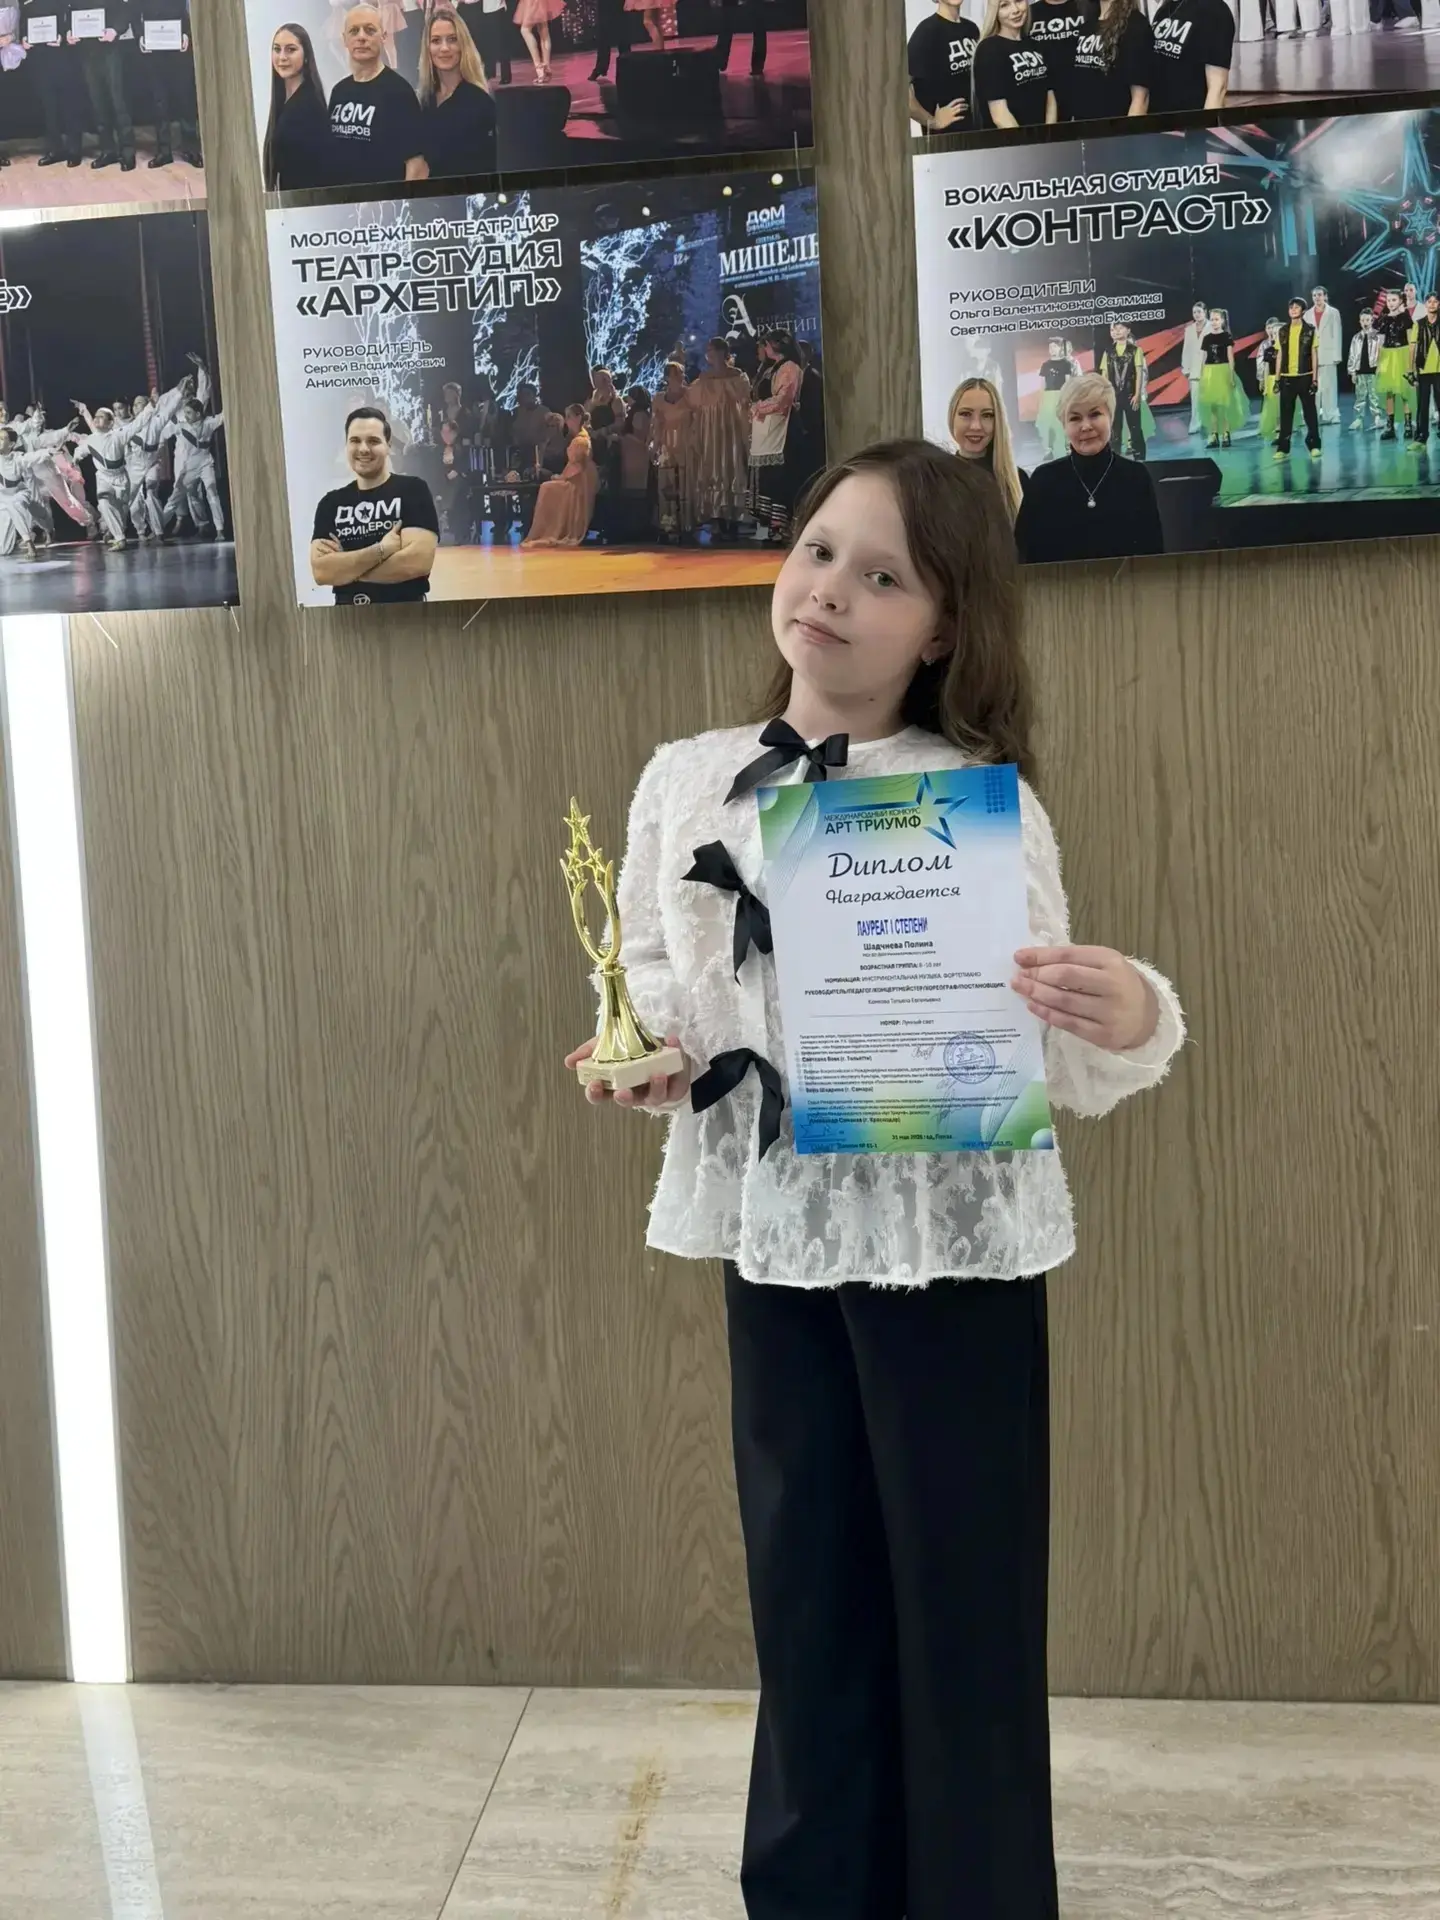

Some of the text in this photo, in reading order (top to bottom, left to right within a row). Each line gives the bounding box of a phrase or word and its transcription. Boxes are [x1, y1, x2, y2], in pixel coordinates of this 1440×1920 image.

[1029, 15, 1085, 36] ДОМ
[1152, 17, 1192, 44] ОМ
[944, 163, 1220, 207] ВОКАЛЬНАЯ СТУДИЯ
[746, 204, 785, 226] ДОМ
[946, 192, 1272, 252] «КОНТРАСТ»
[290, 214, 559, 249] МОЛОДЁЖНЫЙ ТЕАТР ЦКР
[292, 239, 562, 284] ТЕАТР-СТУДИЯ
[718, 232, 819, 278] МИШЕЛЬ
[296, 273, 562, 318] «АРХЕТИП»
[949, 279, 1097, 305] РУКОВОДИТЕЛИ
[949, 292, 1163, 322] Ольга Валентиновна Салмина
[950, 308, 1166, 338] Светлана Викторовна Бисяева
[303, 340, 433, 359] РУКОВОДИТЕЛЬ
[303, 357, 446, 377] Сергей Владимирович
[305, 375, 380, 390] Анисимов
[335, 497, 402, 527] ДОМ
[825, 814, 921, 835] АРТ ТРИУМФ
[828, 852, 953, 878] Диплом
[825, 885, 961, 906] Награждается
[857, 918, 888, 937] ЛАУРЕАТ
[895, 917, 928, 935] СТЕПЕНИ
[904, 940, 934, 948] Полина
